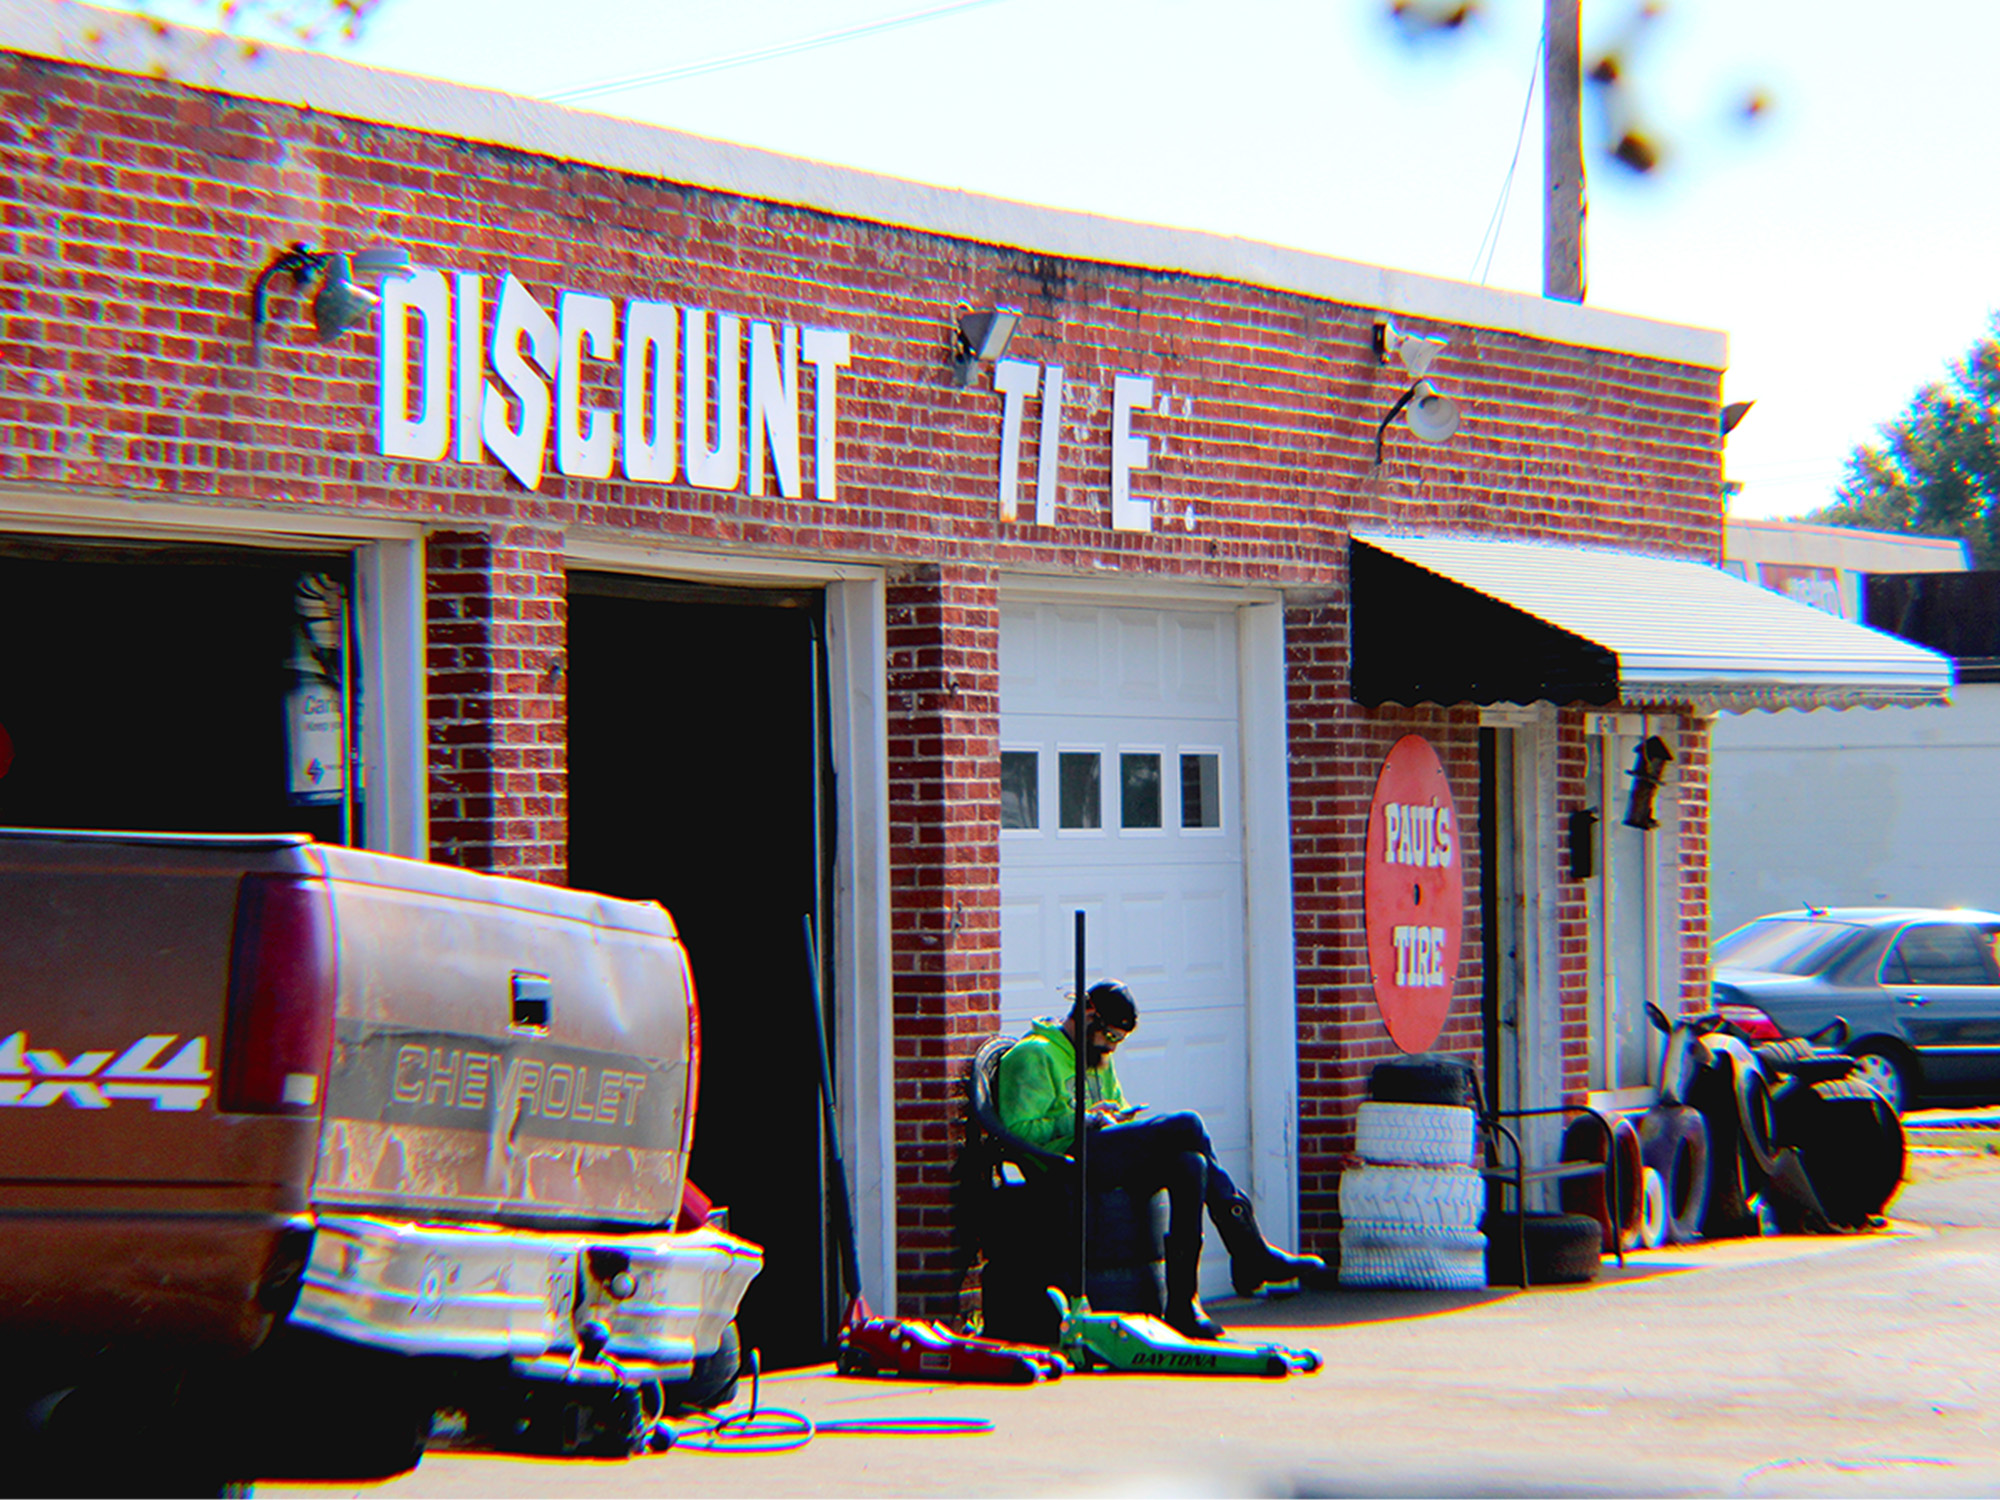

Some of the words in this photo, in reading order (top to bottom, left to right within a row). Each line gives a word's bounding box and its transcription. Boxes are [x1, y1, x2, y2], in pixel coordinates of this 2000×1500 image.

[380, 268, 851, 501] DISCOUNT
[1384, 796, 1452, 868] PAUL'S
[1394, 925, 1446, 987] TIRE
[0, 1030, 213, 1112] x4
[392, 1043, 648, 1127] CHEVROLET
[1131, 1352, 1217, 1367] DAYTONA
